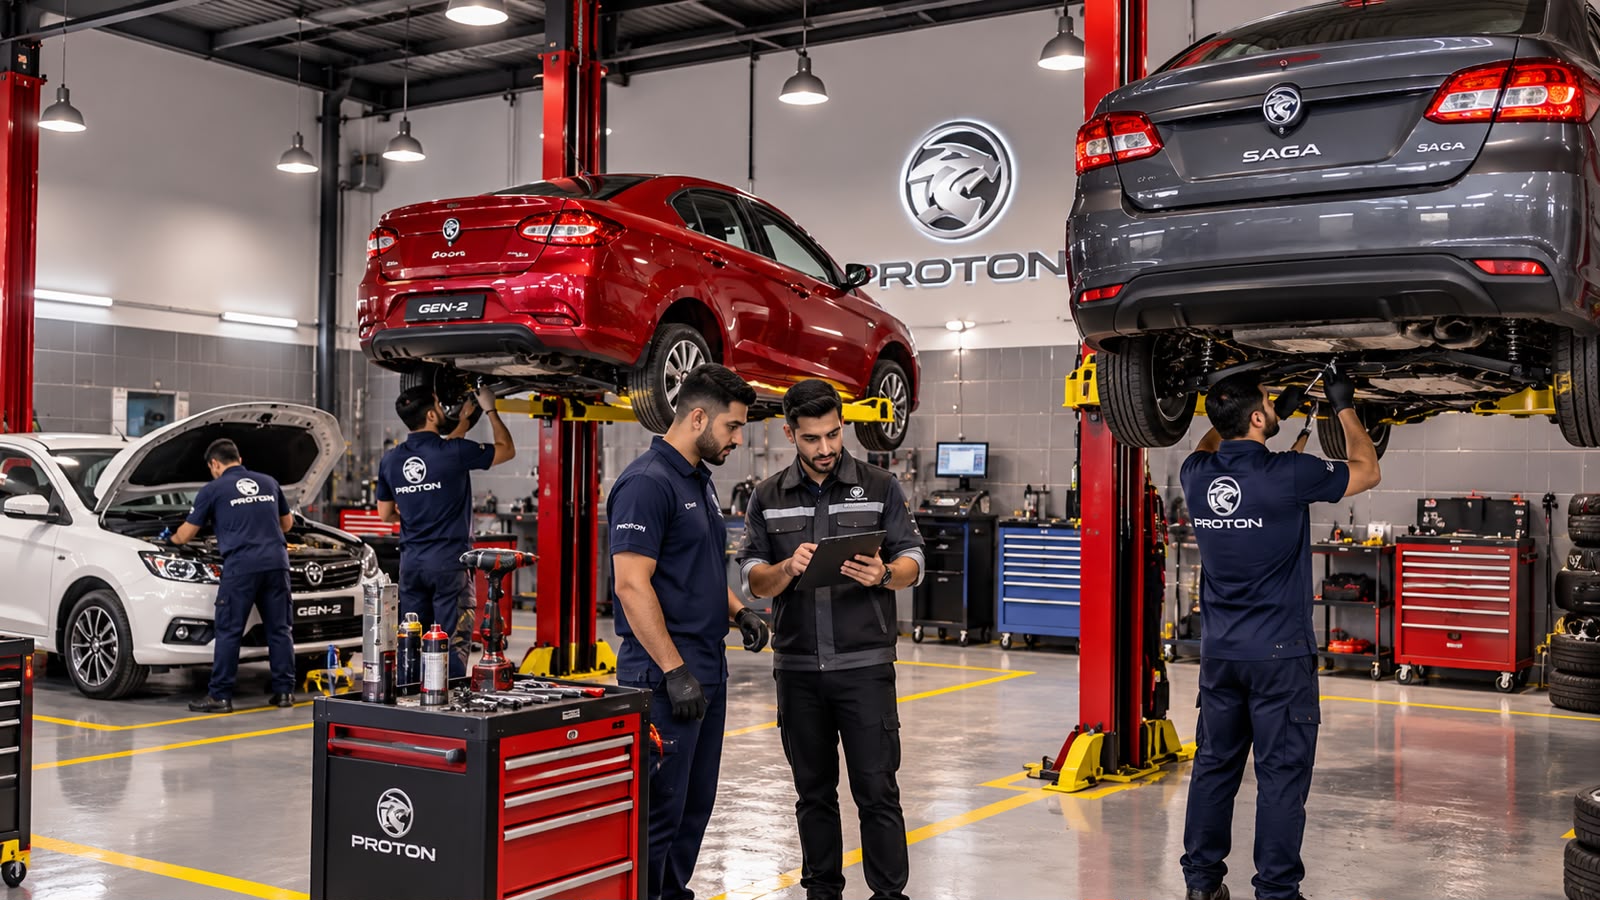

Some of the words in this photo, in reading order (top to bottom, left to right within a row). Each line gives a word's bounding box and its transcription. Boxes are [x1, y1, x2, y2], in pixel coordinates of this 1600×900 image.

[1242, 143, 1322, 163] SAGA
[1416, 141, 1466, 153] SAGA
[418, 301, 469, 314] GEN-2
[395, 481, 442, 495] PROTON
[1194, 517, 1263, 529] PROTON
[297, 604, 342, 617] GEN-2
[351, 834, 436, 862] PROTON
